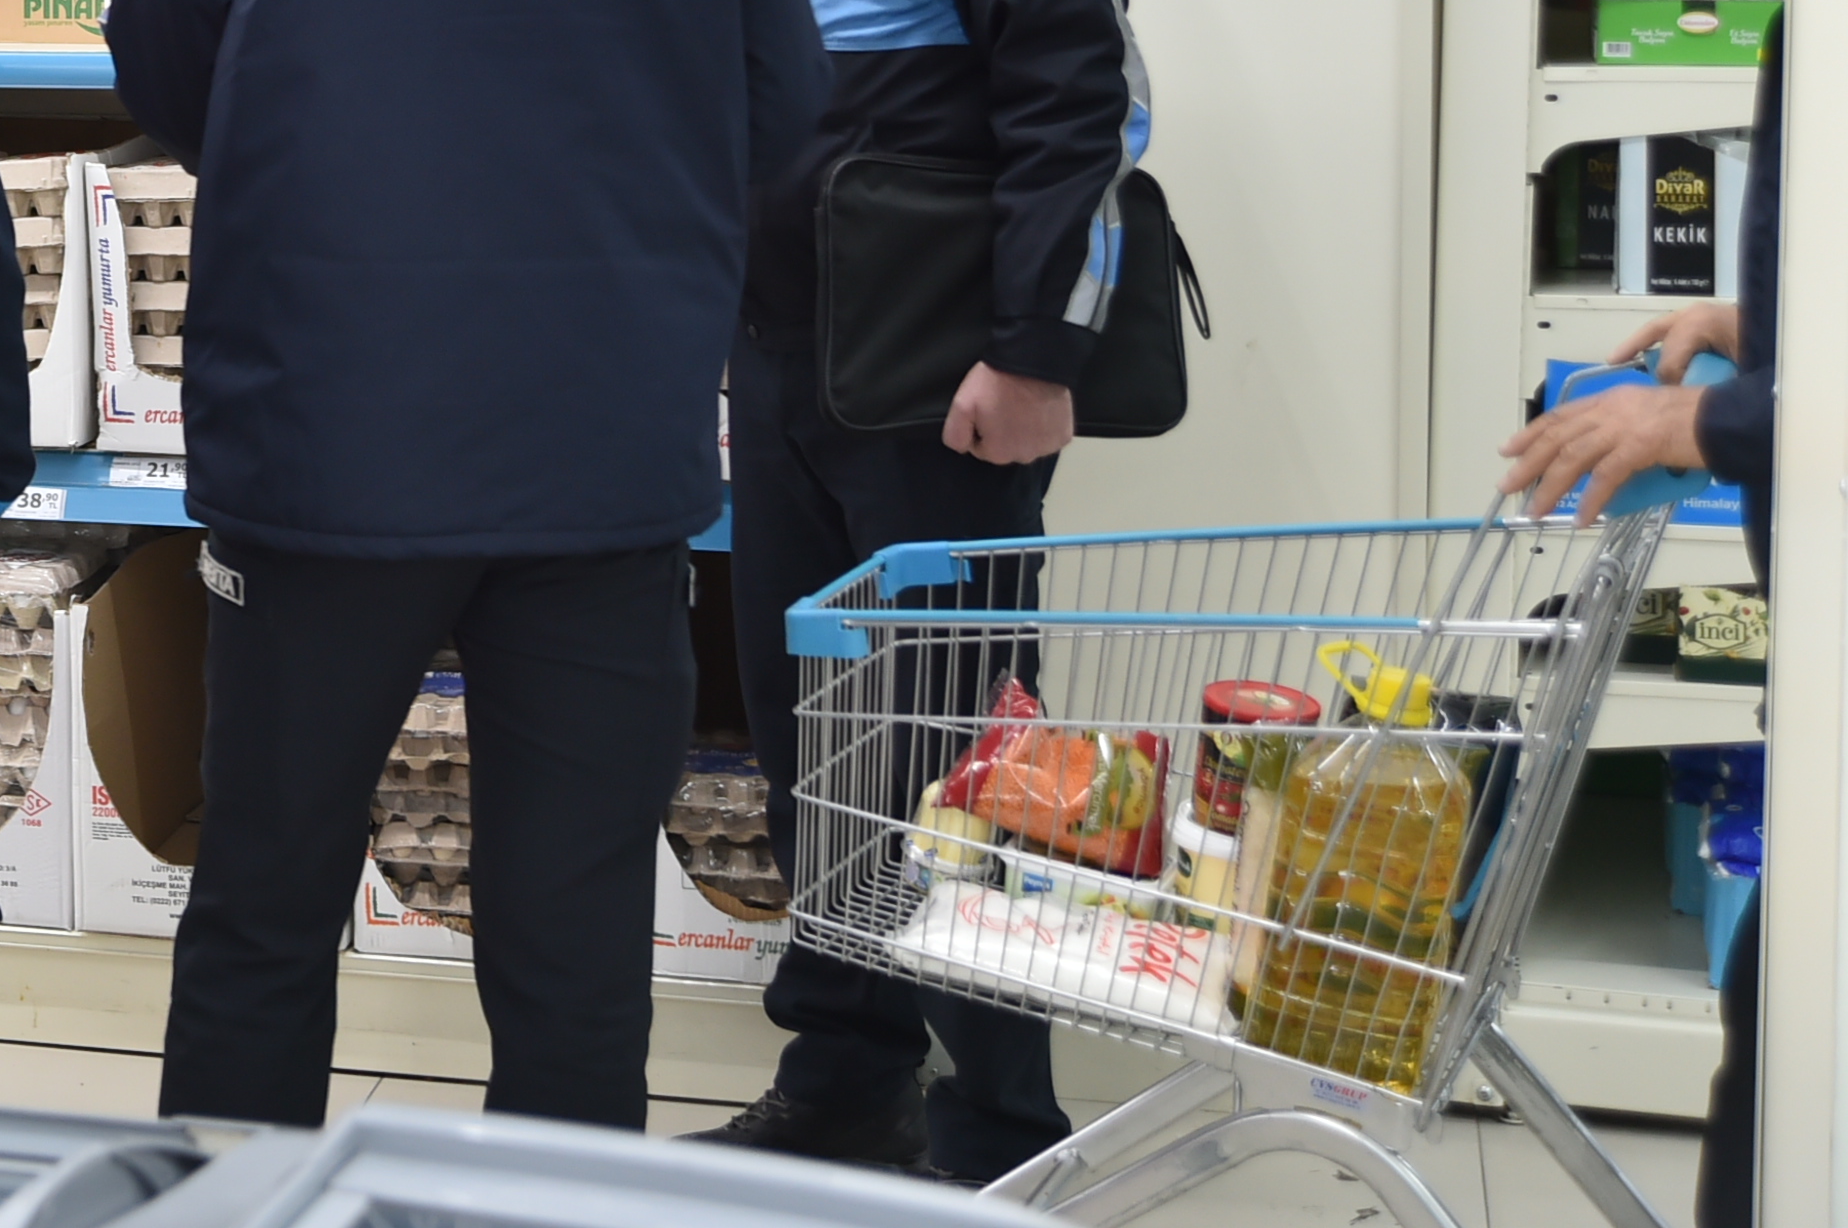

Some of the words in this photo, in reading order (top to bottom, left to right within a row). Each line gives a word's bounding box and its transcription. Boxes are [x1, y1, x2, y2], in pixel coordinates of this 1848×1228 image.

[1654, 224, 1706, 243] KEKİK
[99, 238, 118, 307] yumurta
[100, 308, 117, 372] ercanlar
[1699, 621, 1741, 642] inci
[678, 930, 754, 953] ercanlar
